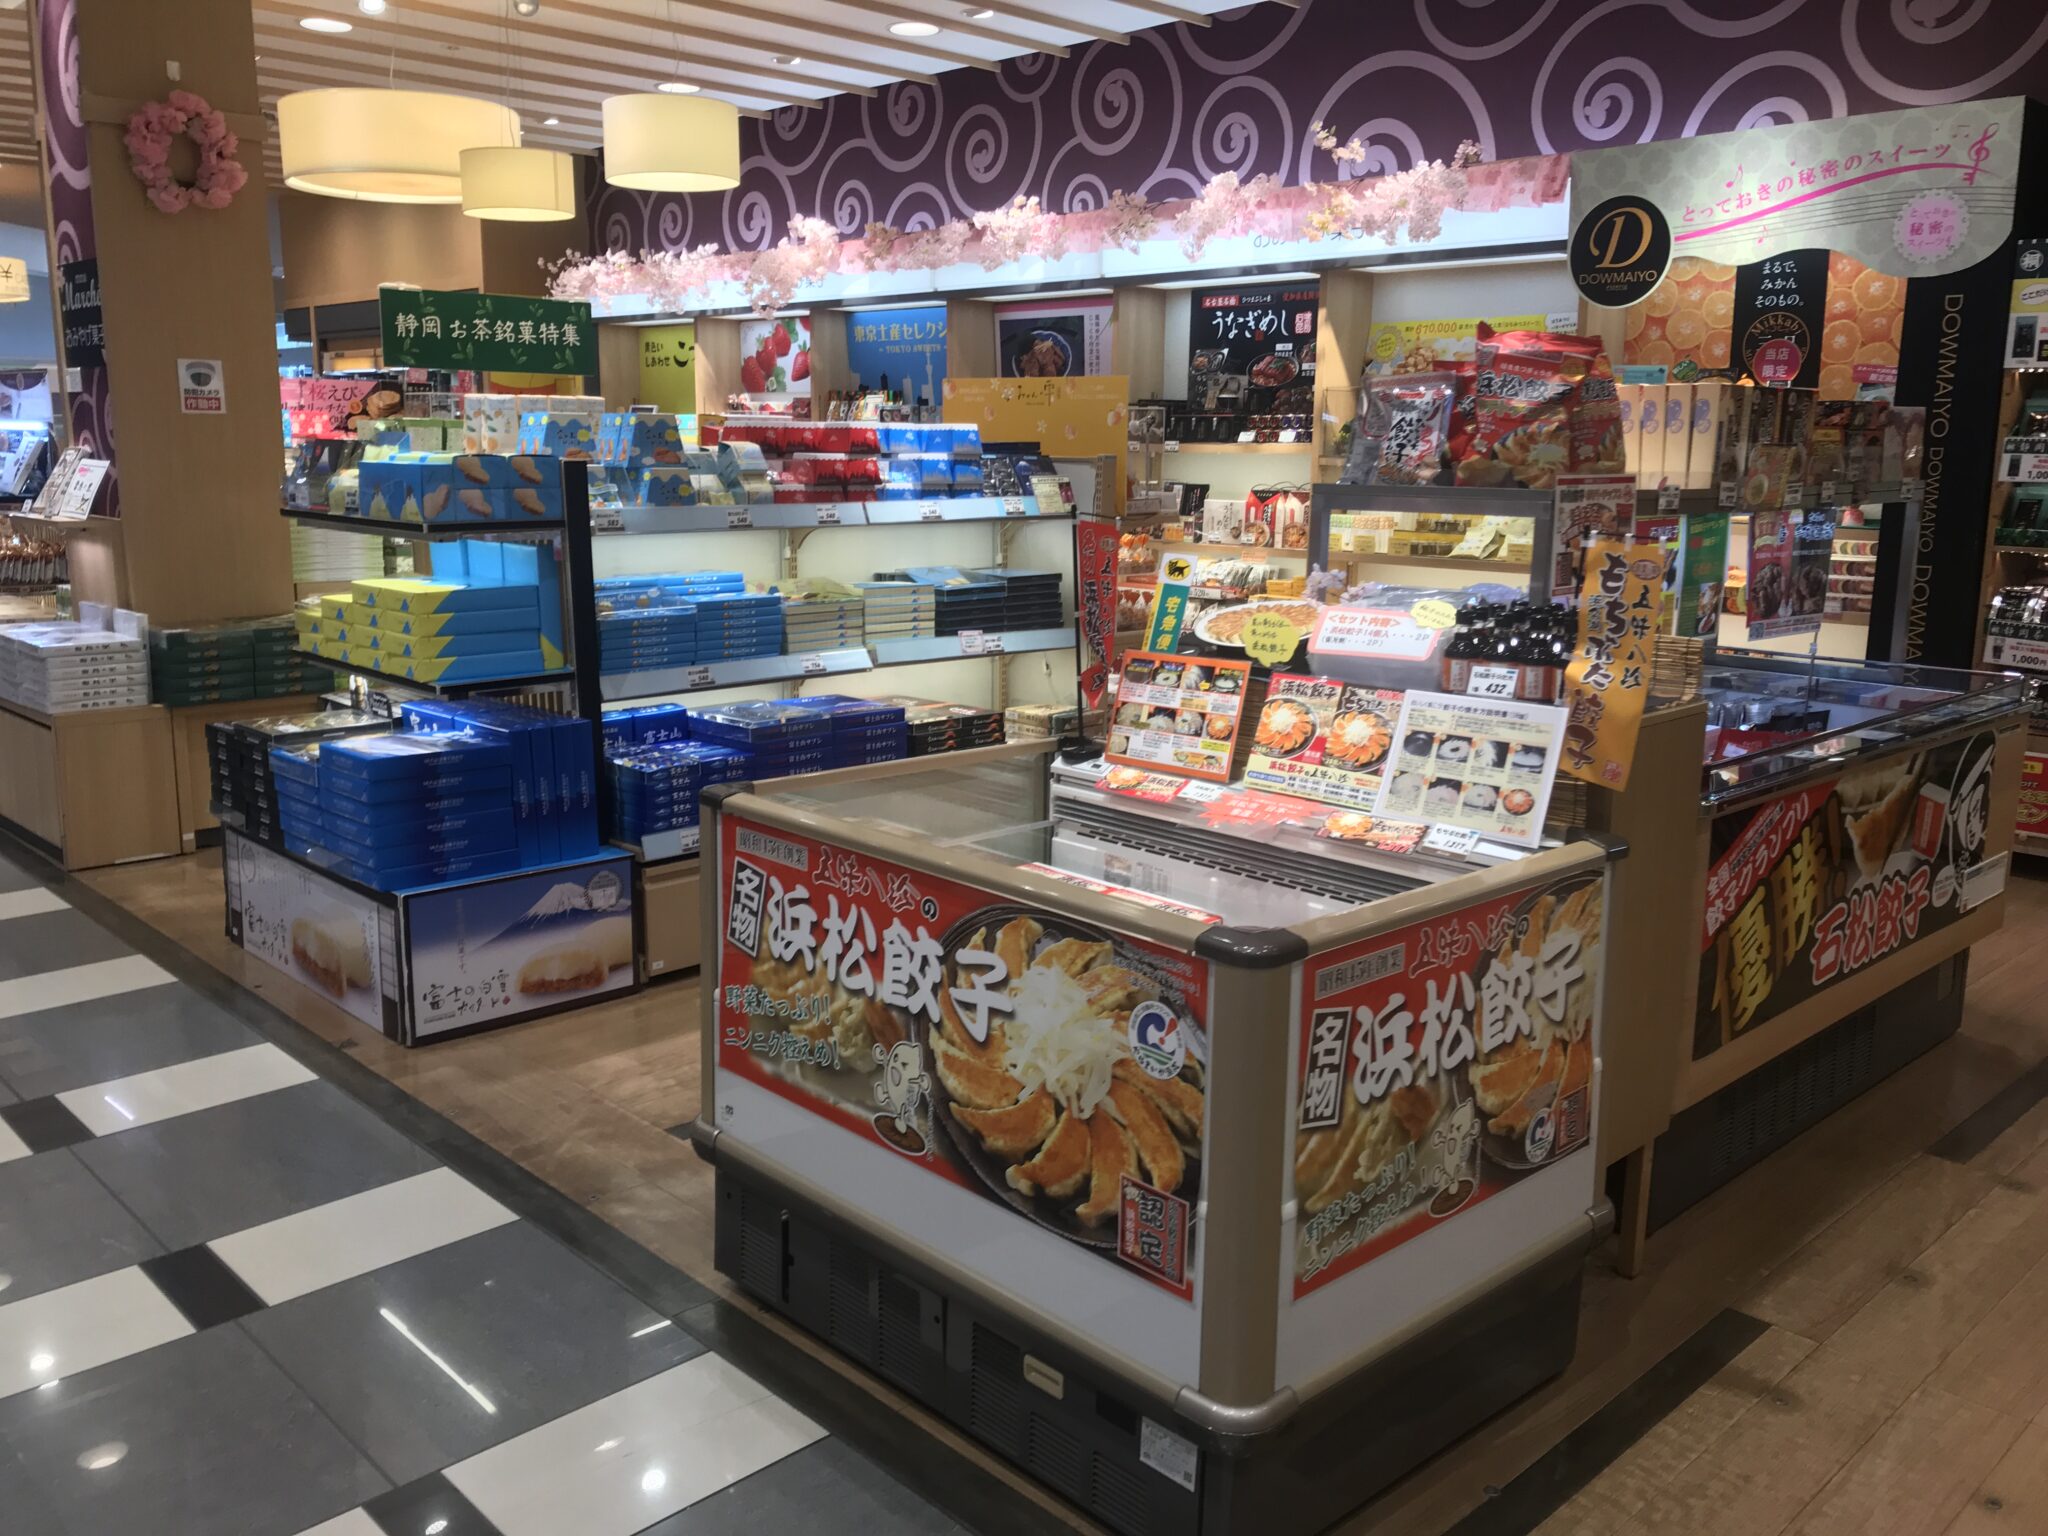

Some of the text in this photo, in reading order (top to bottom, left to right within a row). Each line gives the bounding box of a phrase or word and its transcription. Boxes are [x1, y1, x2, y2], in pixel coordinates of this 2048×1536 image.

[1682, 142, 1952, 223] とっておきの秘密のスイーツ
[1589, 207, 1653, 269] D
[1578, 269, 1658, 286] DOWMAIYO
[1760, 277, 1798, 290] みかん
[394, 311, 582, 347] 静岡 お茶銘菓特集
[1212, 309, 1289, 340] うなぎめし
[1415, 322, 1457, 335] 670,000
[644, 356, 671, 368] しあわせ
[885, 345, 911, 354] TOKYO
[1765, 348, 1790, 361] 当店
[1930, 294, 1965, 438] DOWMAIYO
[1761, 364, 1788, 378] 限定
[185, 398, 221, 410] 作動中
[309, 384, 358, 401] 桜えび
[1919, 447, 1945, 553] DOWMAIYO
[1156, 595, 1181, 651] 宅急便
[1620, 584, 1654, 689] 五味八珍
[1281, 679, 1338, 699] 浜松餃子
[1484, 683, 1506, 694] 432
[643, 727, 683, 744] 富士山
[731, 867, 763, 949] 名物
[1810, 864, 1931, 986] 石松餃子
[1727, 825, 1826, 1031] 優勝
[766, 875, 1014, 1044] 浜松餃子
[422, 968, 511, 1011] 富士の白雪
[1352, 930, 1585, 1104] 浜松餃子
[1305, 1016, 1339, 1119] 名物
